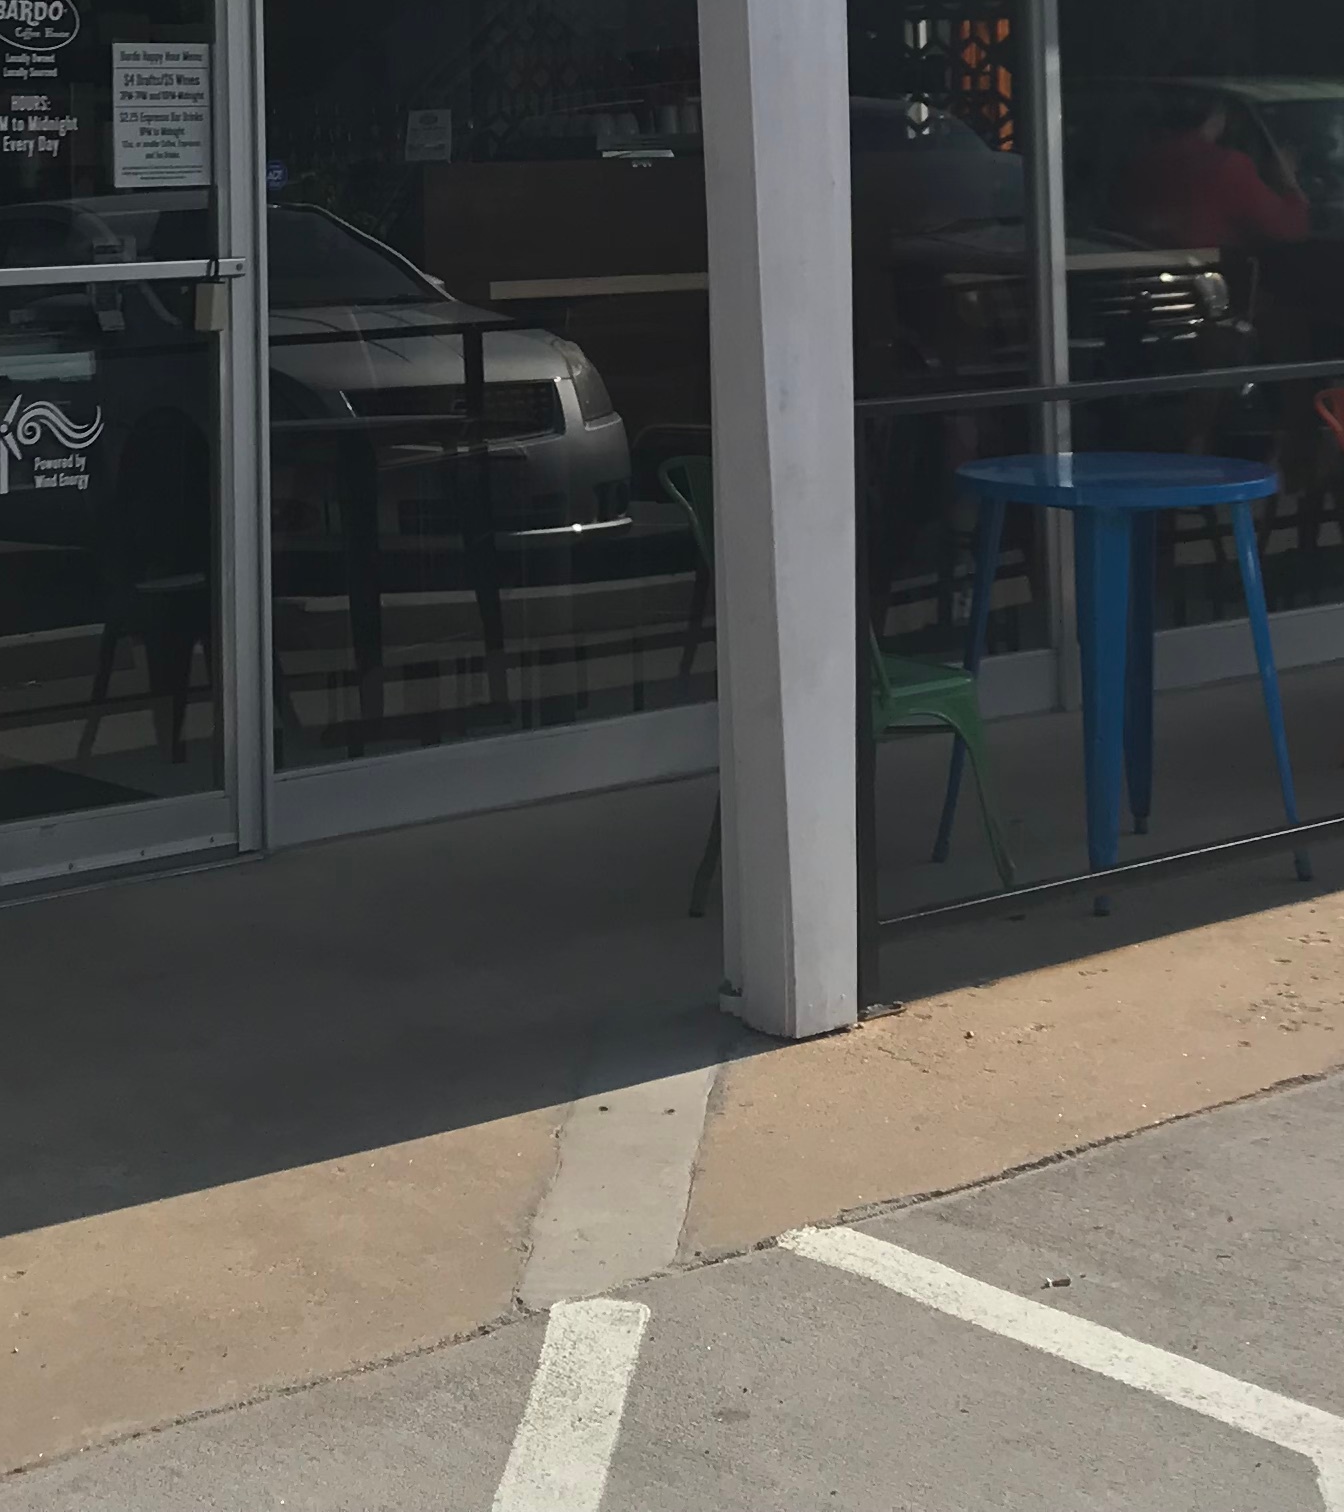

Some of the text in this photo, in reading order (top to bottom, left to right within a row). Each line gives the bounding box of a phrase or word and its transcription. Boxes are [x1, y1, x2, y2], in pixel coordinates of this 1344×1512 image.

[15, 27, 41, 40] Coffee
[12, 117, 24, 131] to
[28, 115, 78, 136] Midnight
[3, 136, 59, 157] Every Day
[34, 454, 86, 472] Powered by
[34, 473, 90, 490] Wind Energy
